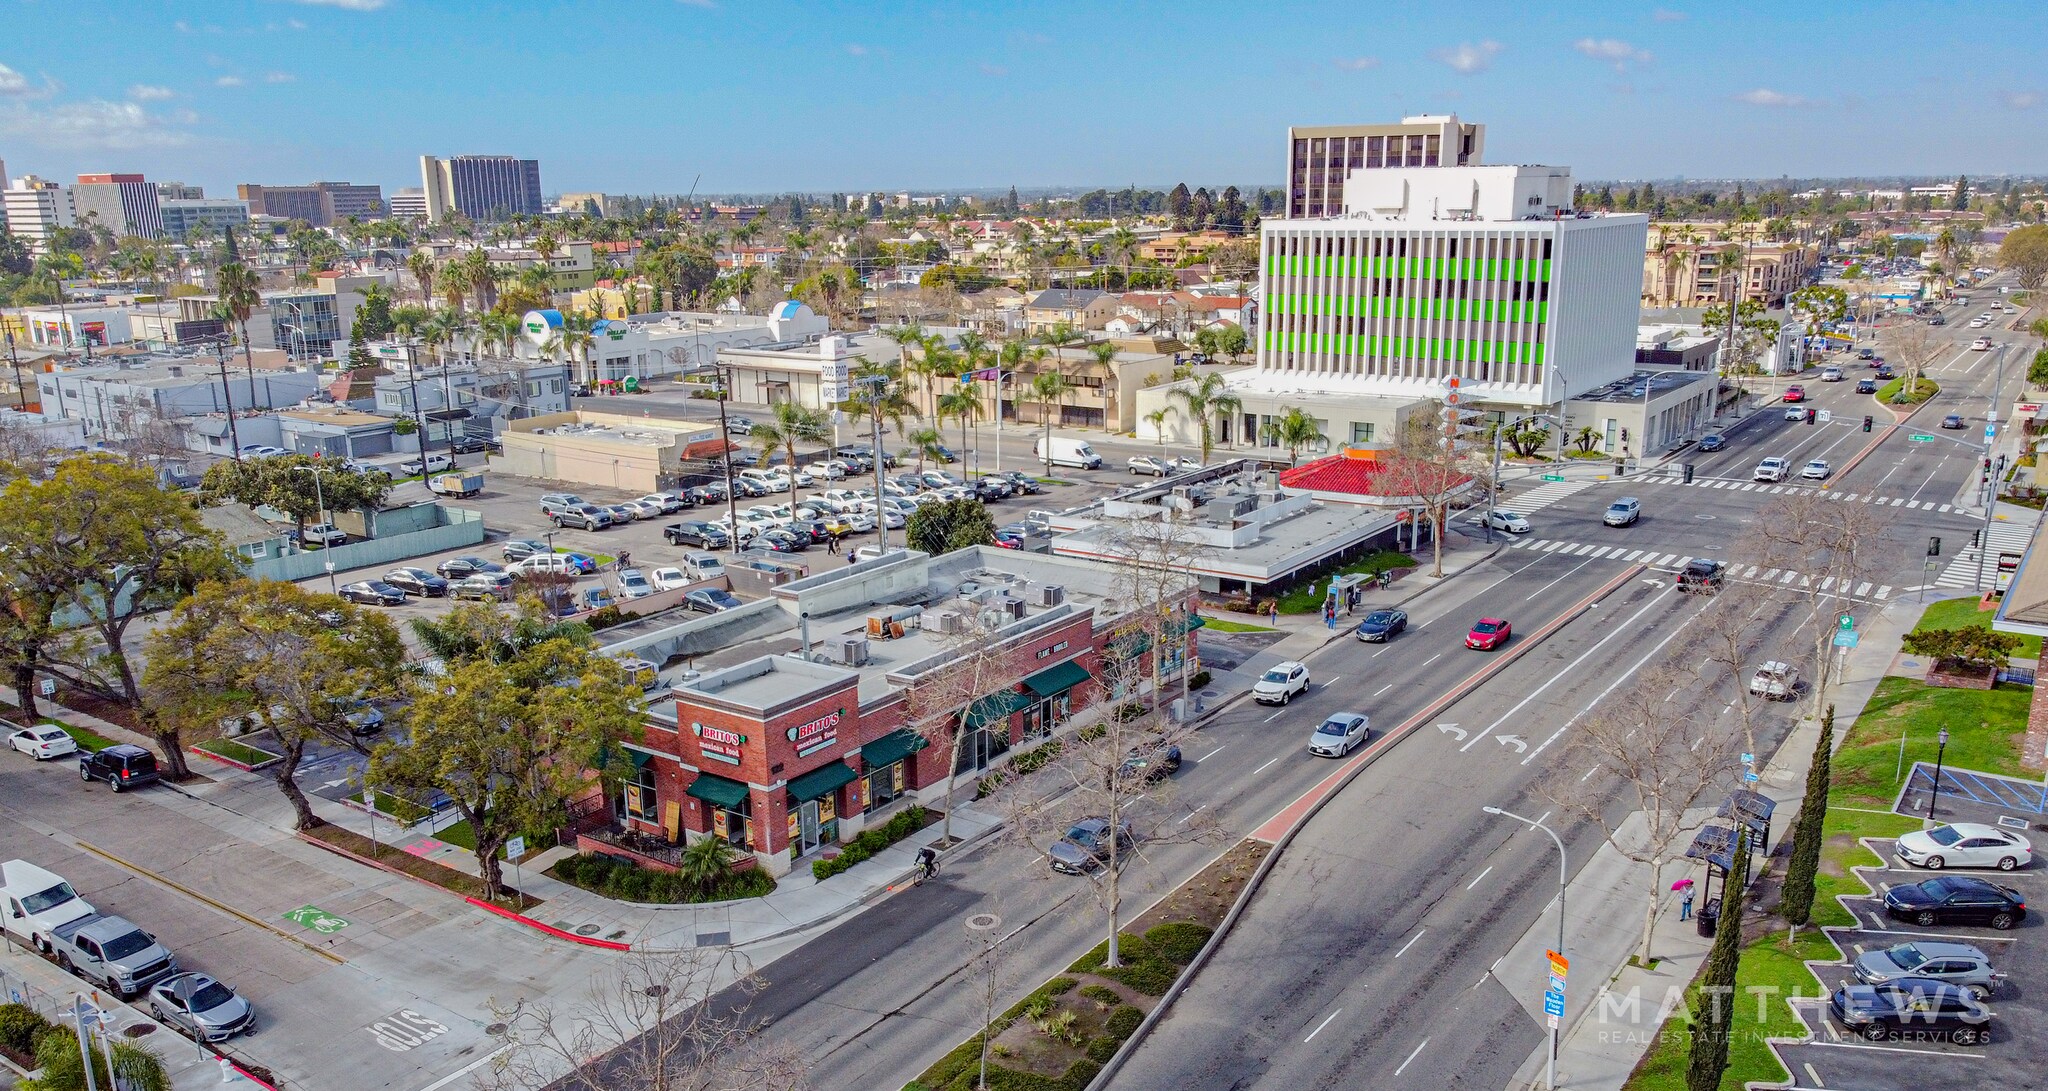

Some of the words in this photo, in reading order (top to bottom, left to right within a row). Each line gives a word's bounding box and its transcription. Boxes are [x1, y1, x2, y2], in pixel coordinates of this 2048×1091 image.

[607, 329, 627, 337] DOLLAR
[822, 365, 835, 377] FOOD
[835, 365, 847, 377] FOOD
[43, 686, 54, 694] 25
[798, 712, 840, 740] BRITO'S
[702, 725, 740, 746] BRITO'S
[796, 735, 823, 751] mexican
[824, 728, 837, 741] food
[699, 741, 725, 753] mexican
[726, 747, 740, 758] food
[365, 1009, 449, 1052] STOP
